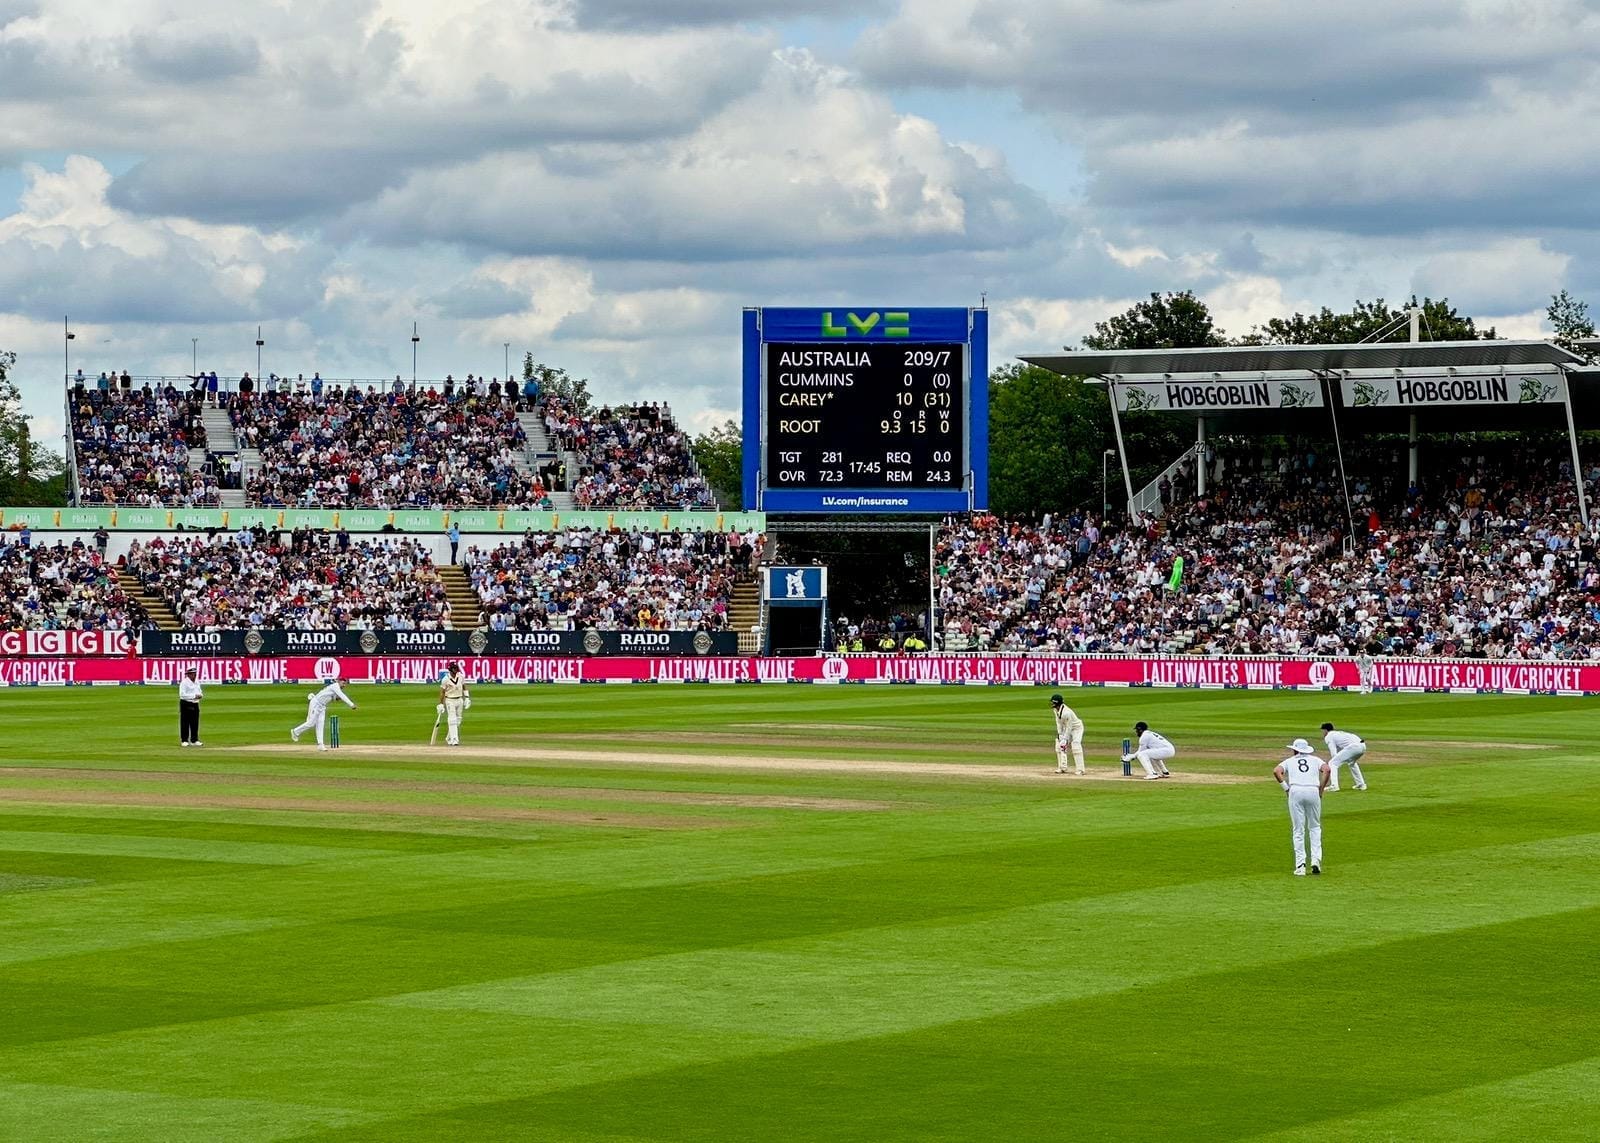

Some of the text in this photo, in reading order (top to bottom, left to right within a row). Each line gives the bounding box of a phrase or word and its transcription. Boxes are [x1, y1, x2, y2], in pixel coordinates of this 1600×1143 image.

[779, 351, 951, 368] AUSTRALIA 209/7
[779, 373, 951, 389] CUMMINS 0 (0)
[1166, 383, 1270, 407] HOBGOBLIN
[1397, 378, 1509, 403] HOBGOBLIN
[896, 392, 913, 406] 10
[924, 392, 951, 408] (31)
[893, 410, 950, 420] O R W
[779, 420, 950, 434] ROOT 9.3 15 0
[779, 451, 951, 465] TGT 281 REQ 0.0
[849, 462, 882, 474] 17:45
[779, 471, 951, 482] OVR 72.3 REM 24.3
[822, 496, 909, 508] LV.com/insurance
[1, 632, 21, 654] G
[34, 632, 59, 654] IG
[72, 632, 97, 654] IG
[171, 633, 221, 644] RADO
[287, 633, 337, 644] RADO
[397, 633, 446, 644] RADO
[511, 633, 560, 644] RADO
[621, 634, 670, 645] RADO
[249, 659, 287, 680] WINE
[321, 661, 333, 674] LW
[368, 659, 584, 680] LAITHWAITS.CO.UK/CRICKET
[650, 659, 794, 680] LAITHWAITES WINE
[829, 661, 841, 674] LW
[876, 660, 1082, 682] LAITHWAITES.CO.UK/CRICKET
[1143, 662, 1282, 684] LAITHWAITES WINE
[1315, 665, 1327, 678] LW
[1371, 664, 1581, 690] AITHWAITES.CO.UK/CRICKET
[1298, 759, 1309, 773] 8
